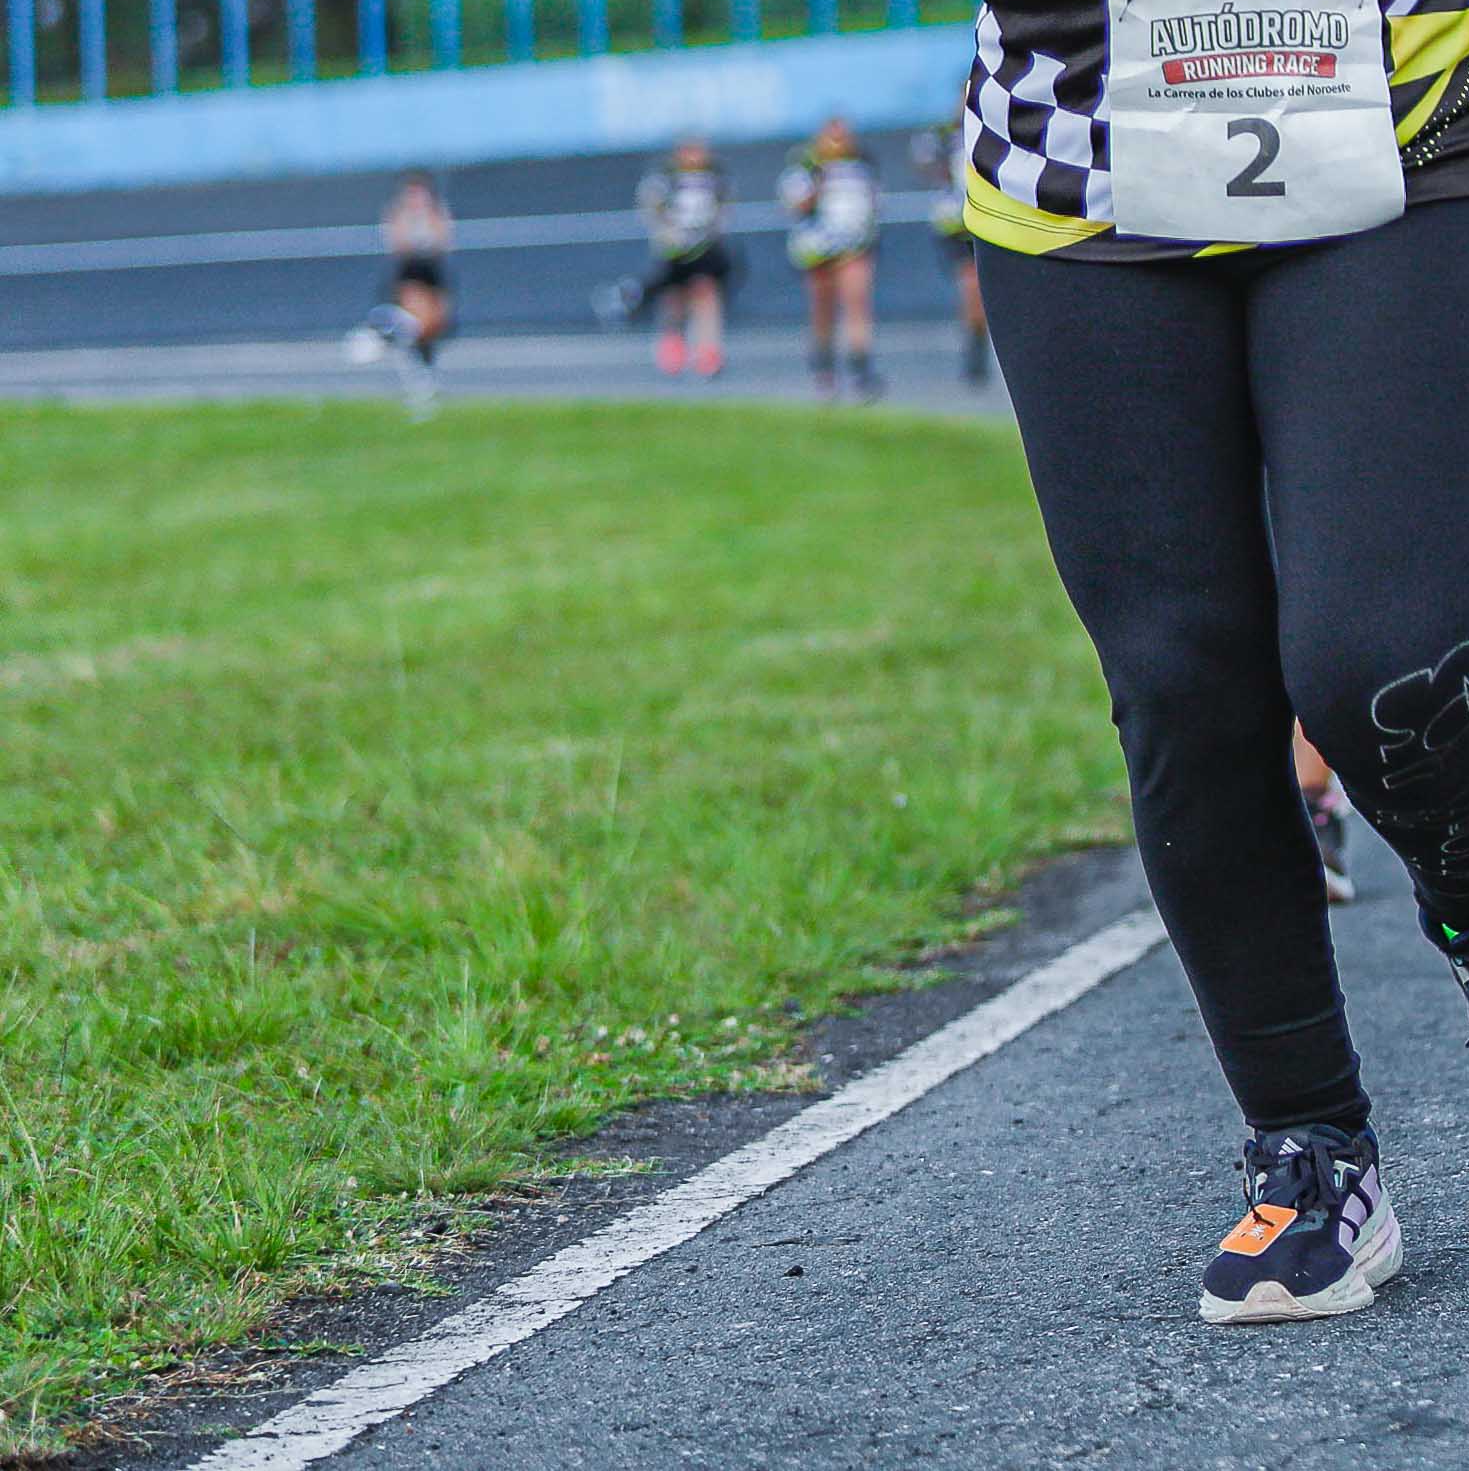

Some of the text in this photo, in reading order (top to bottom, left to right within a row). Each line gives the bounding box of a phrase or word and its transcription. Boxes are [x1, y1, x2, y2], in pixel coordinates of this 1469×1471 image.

[1150, 2, 1349, 57] AUTÓDROMO
[1182, 53, 1321, 81] RUNNING RACE
[1148, 82, 1351, 99] La Carrera de los Clubes del Noroeste
[1226, 117, 1286, 197] 2
